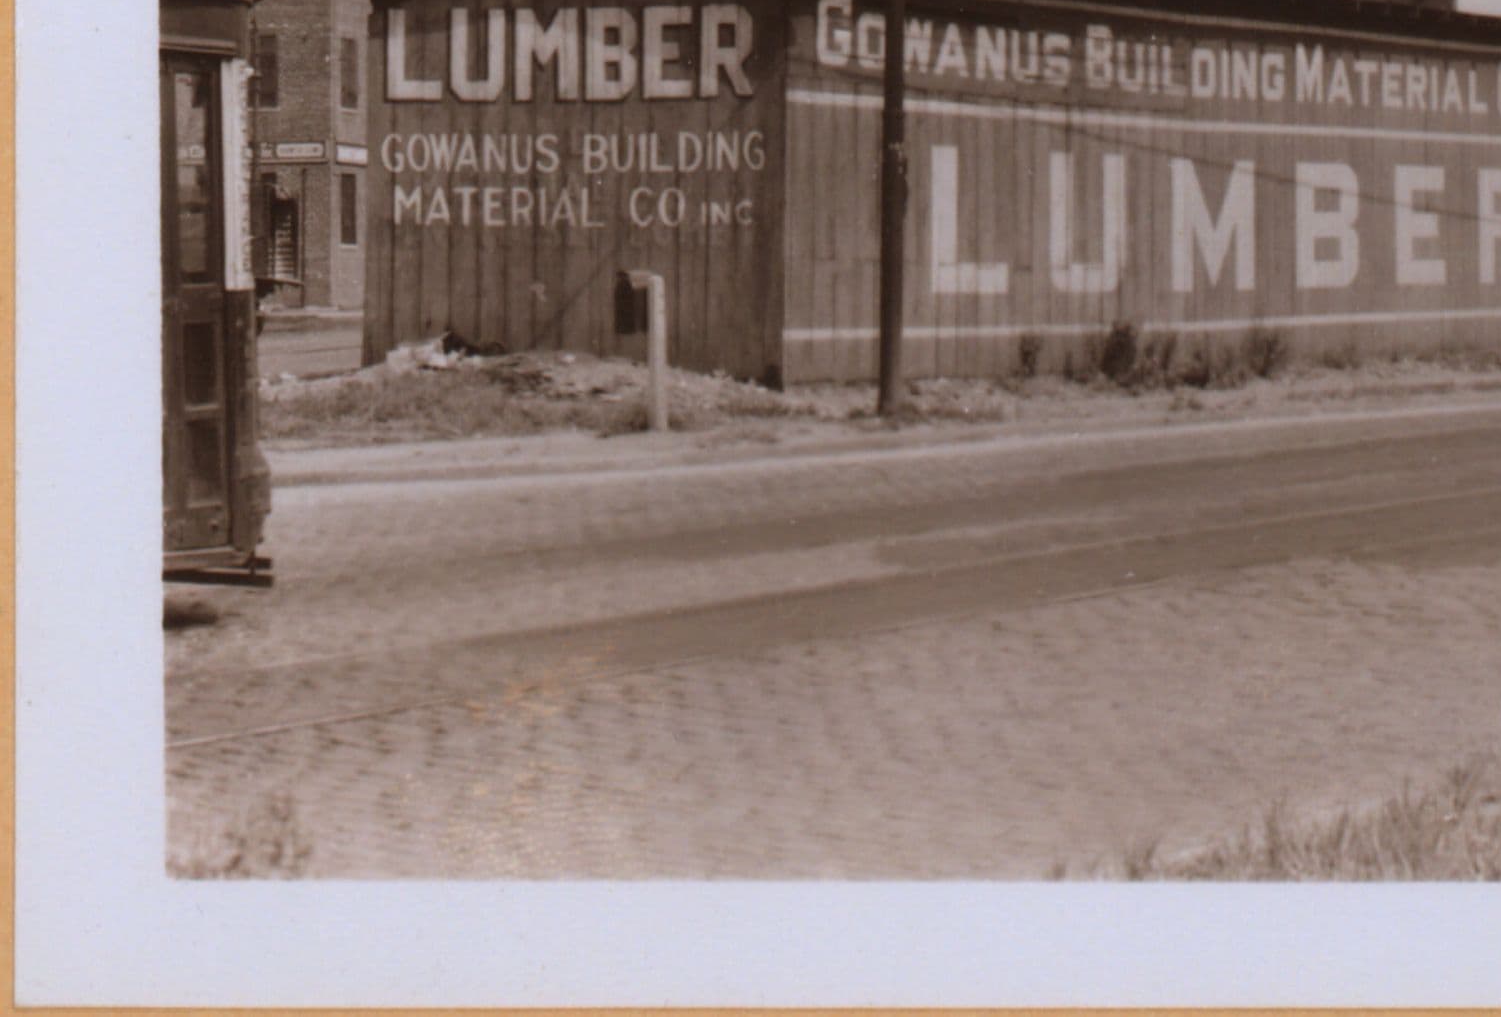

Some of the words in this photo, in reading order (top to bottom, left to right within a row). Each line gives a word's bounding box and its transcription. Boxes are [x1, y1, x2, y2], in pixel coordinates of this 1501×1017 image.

[385, 4, 755, 102] LUMBER
[1085, 23, 1286, 102] BUILDING
[1295, 42, 1489, 114] MATERIAL
[380, 132, 562, 175] GOWANUS
[583, 130, 767, 175] BUILDING
[393, 185, 606, 228] MATERIAL
[629, 186, 687, 228] CO
[701, 199, 754, 226] INC
